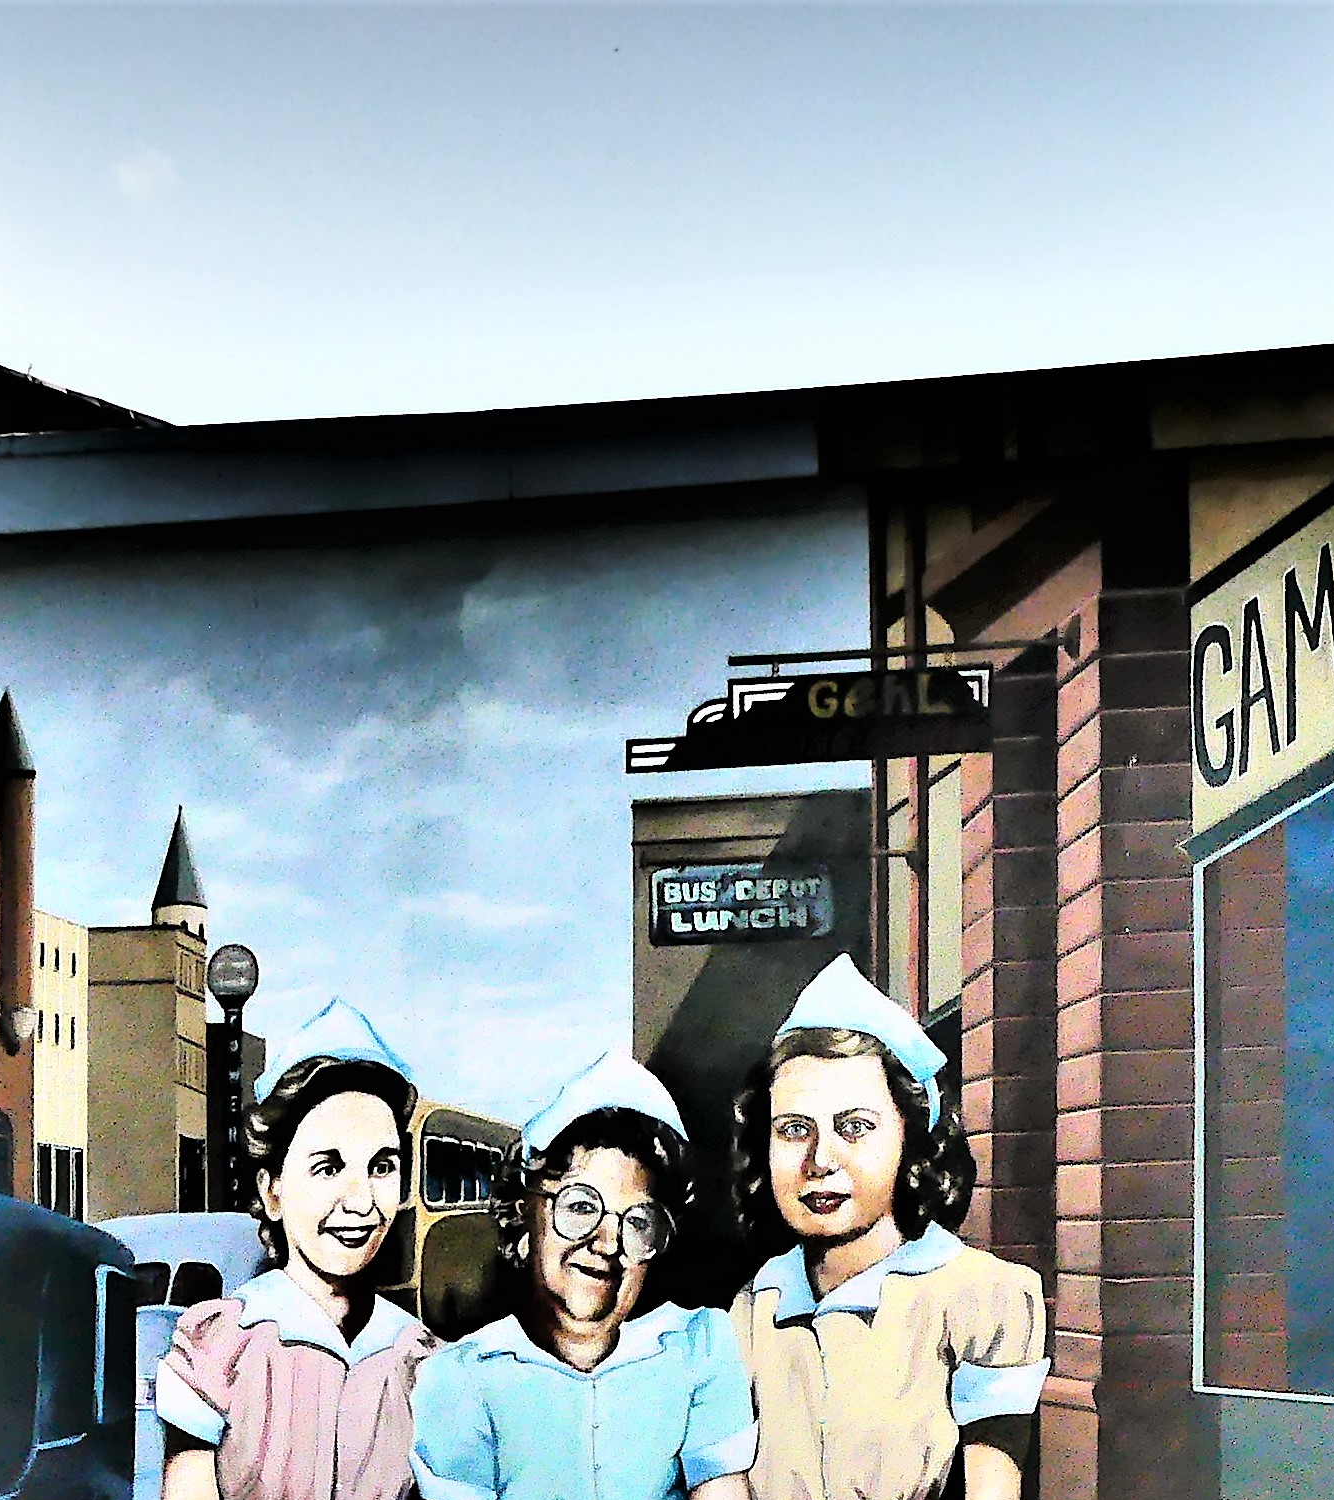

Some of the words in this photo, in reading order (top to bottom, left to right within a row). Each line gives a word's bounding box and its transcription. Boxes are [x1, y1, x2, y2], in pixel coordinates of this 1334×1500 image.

[664, 881, 717, 903] BUS
[735, 877, 821, 902] DEPOT
[670, 907, 808, 933] LUNCH
